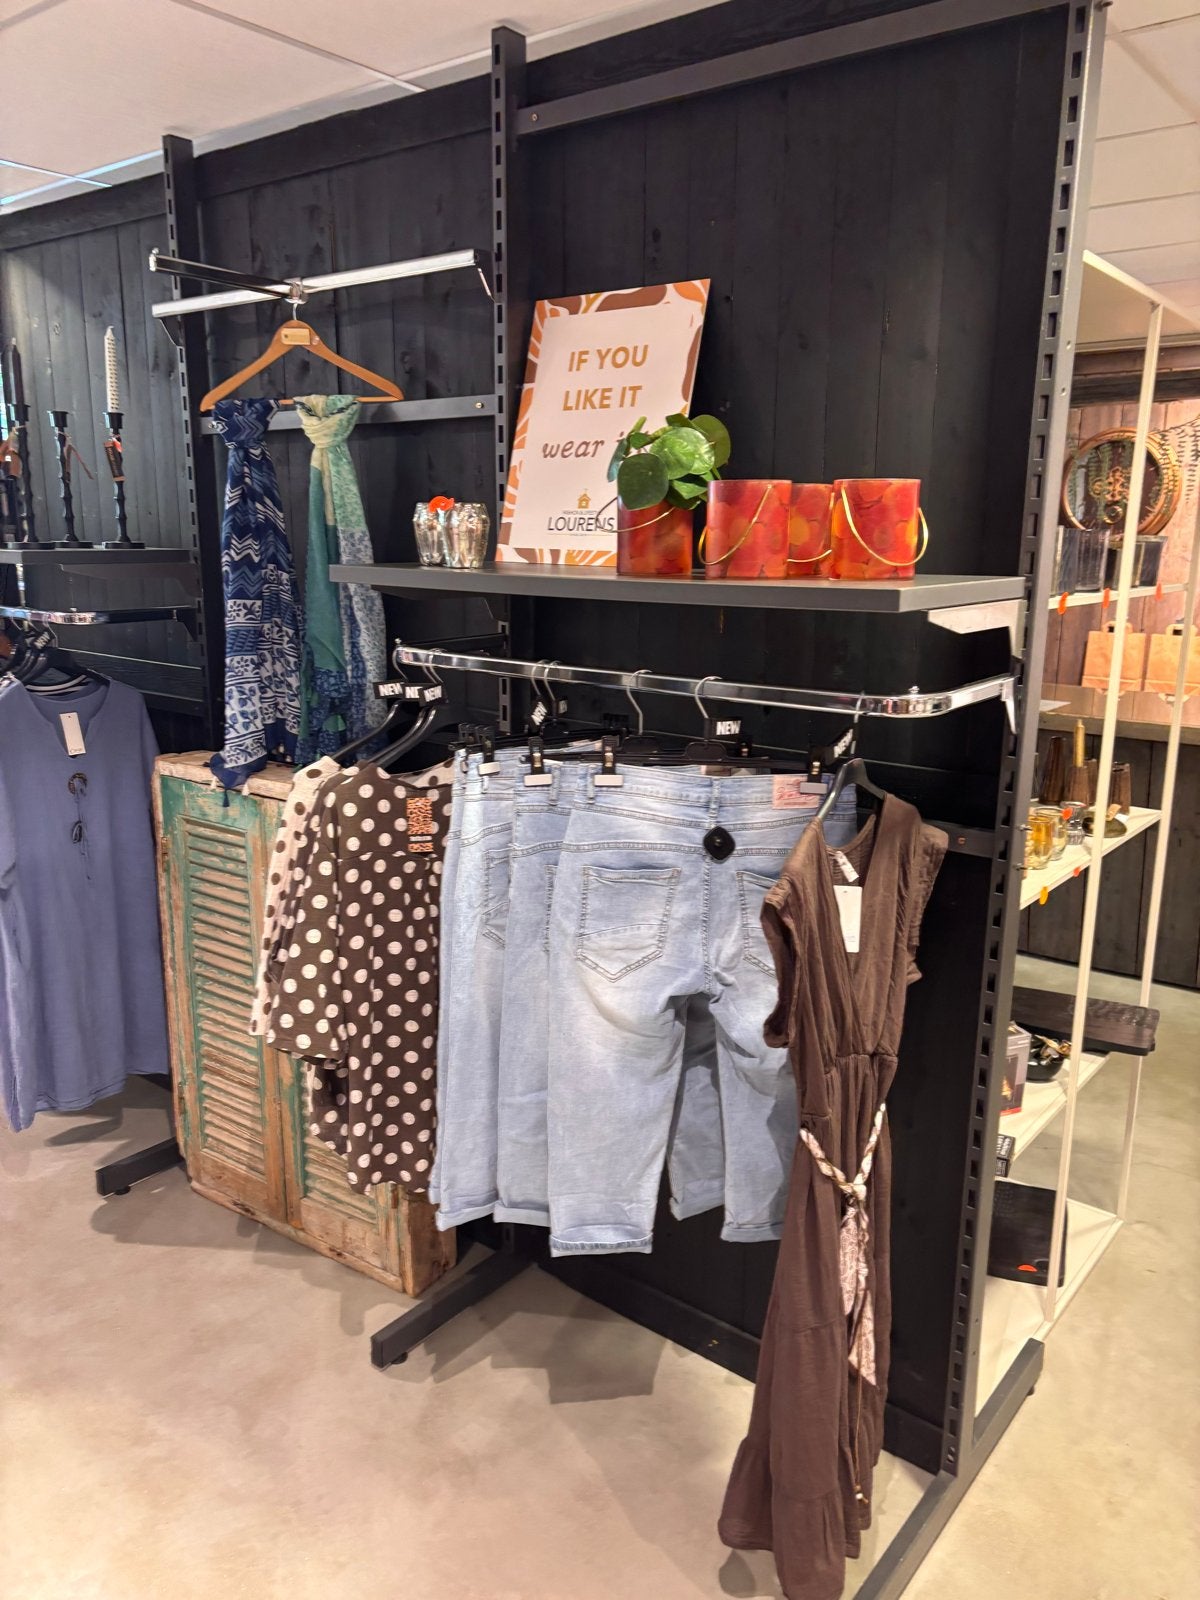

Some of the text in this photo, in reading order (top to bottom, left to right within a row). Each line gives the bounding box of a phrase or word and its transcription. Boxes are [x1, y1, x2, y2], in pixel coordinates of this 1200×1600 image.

[568, 344, 649, 372] IF YOU
[563, 385, 643, 411] LIKE IT
[541, 439, 605, 459] wear
[547, 516, 615, 532] LOURENS
[378, 682, 404, 697] NEW
[405, 686, 424, 699] NE
[423, 685, 442, 703] NEW
[530, 701, 548, 726] NEW
[715, 720, 742, 736] NEW
[833, 728, 854, 758] NEW
